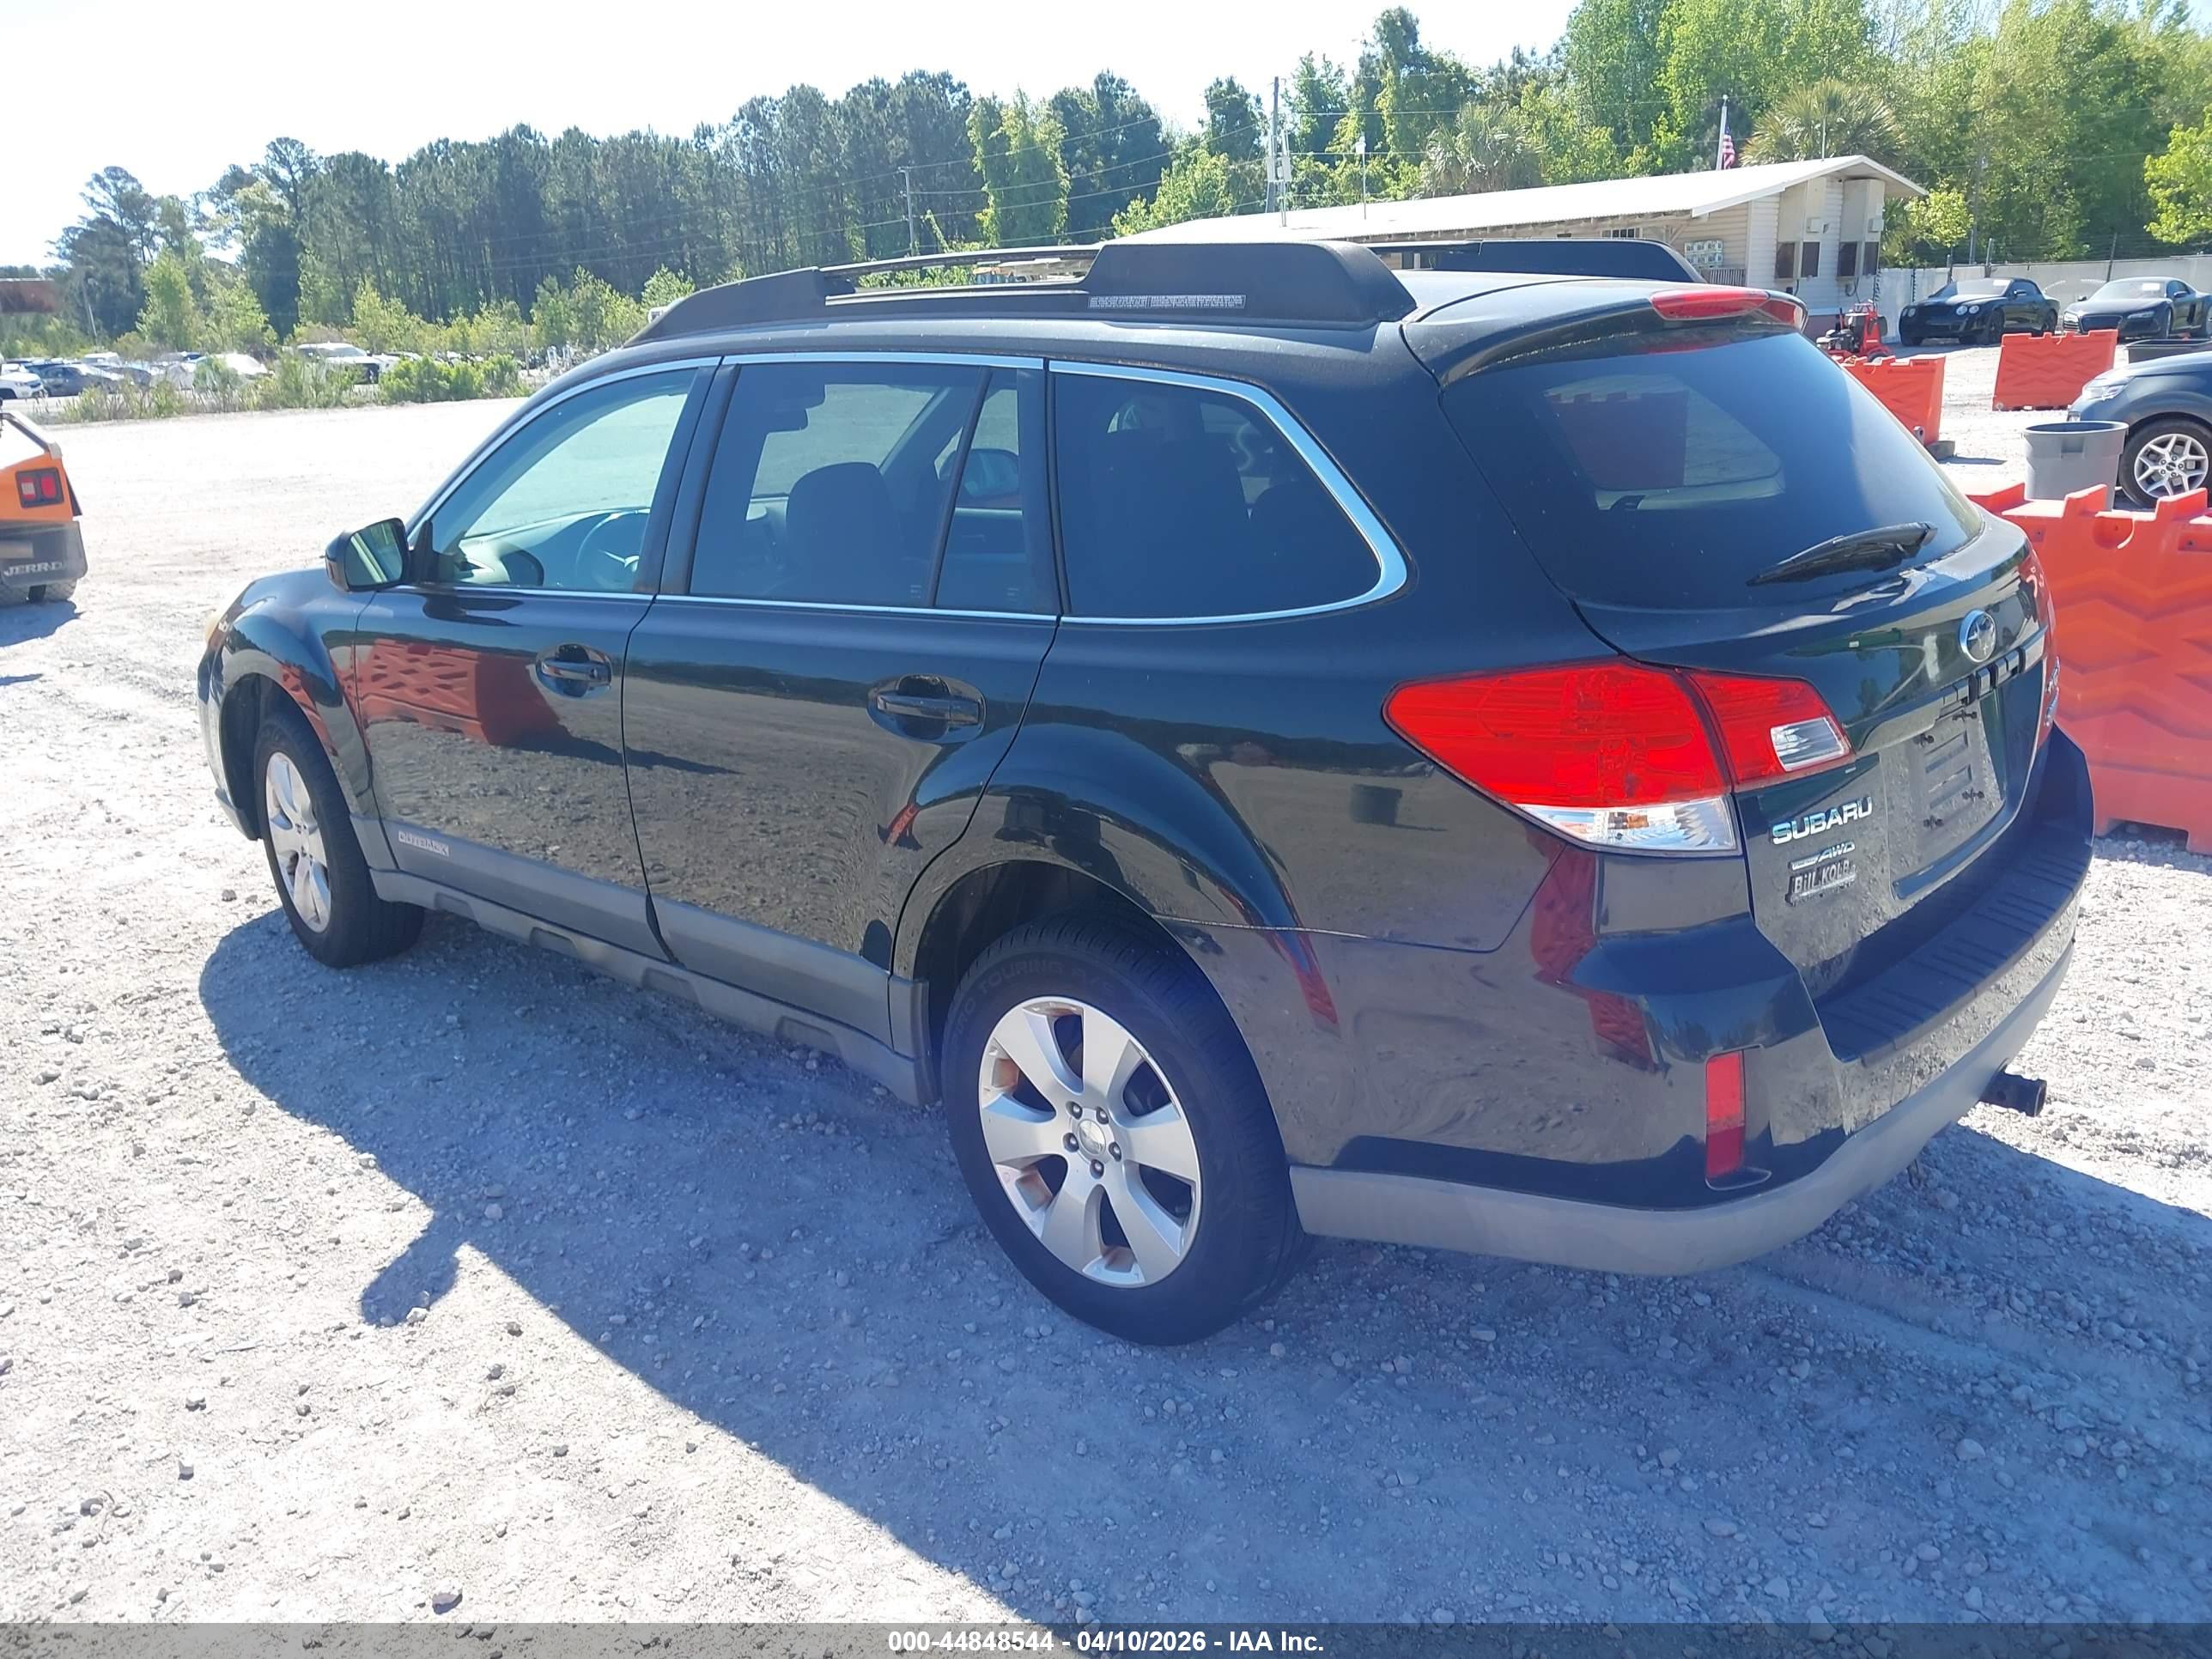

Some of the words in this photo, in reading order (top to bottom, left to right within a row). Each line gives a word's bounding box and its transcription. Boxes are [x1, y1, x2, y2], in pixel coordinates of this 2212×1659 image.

[1771, 796, 1873, 845] SUBARU
[1816, 841, 1856, 862] AWD
[977, 958, 1064, 995] TOURING
